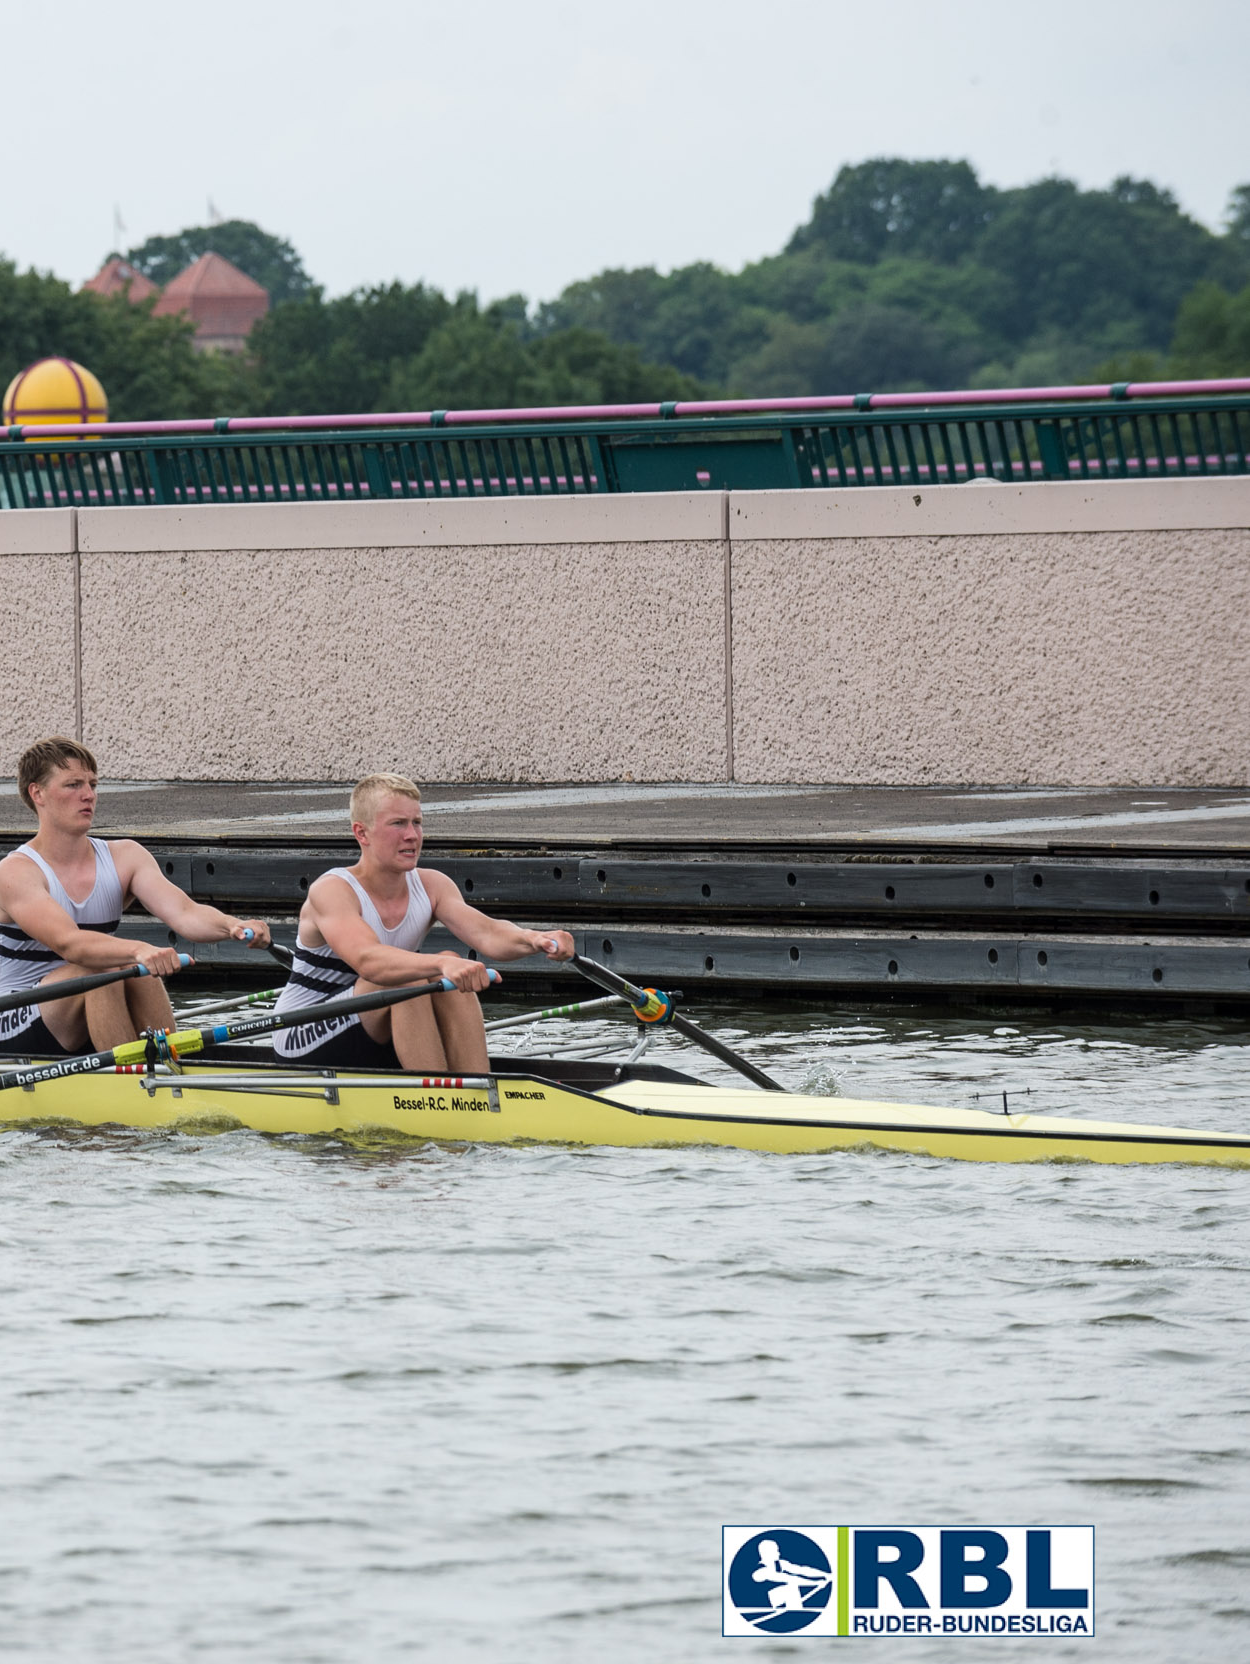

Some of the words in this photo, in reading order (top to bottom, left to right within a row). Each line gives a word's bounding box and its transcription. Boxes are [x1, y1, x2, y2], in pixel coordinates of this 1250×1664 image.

[231, 1018, 272, 1033] concept
[15, 1057, 101, 1085] besselrc.de
[504, 1091, 546, 1100] EMPACHER
[452, 1097, 490, 1111] Minden
